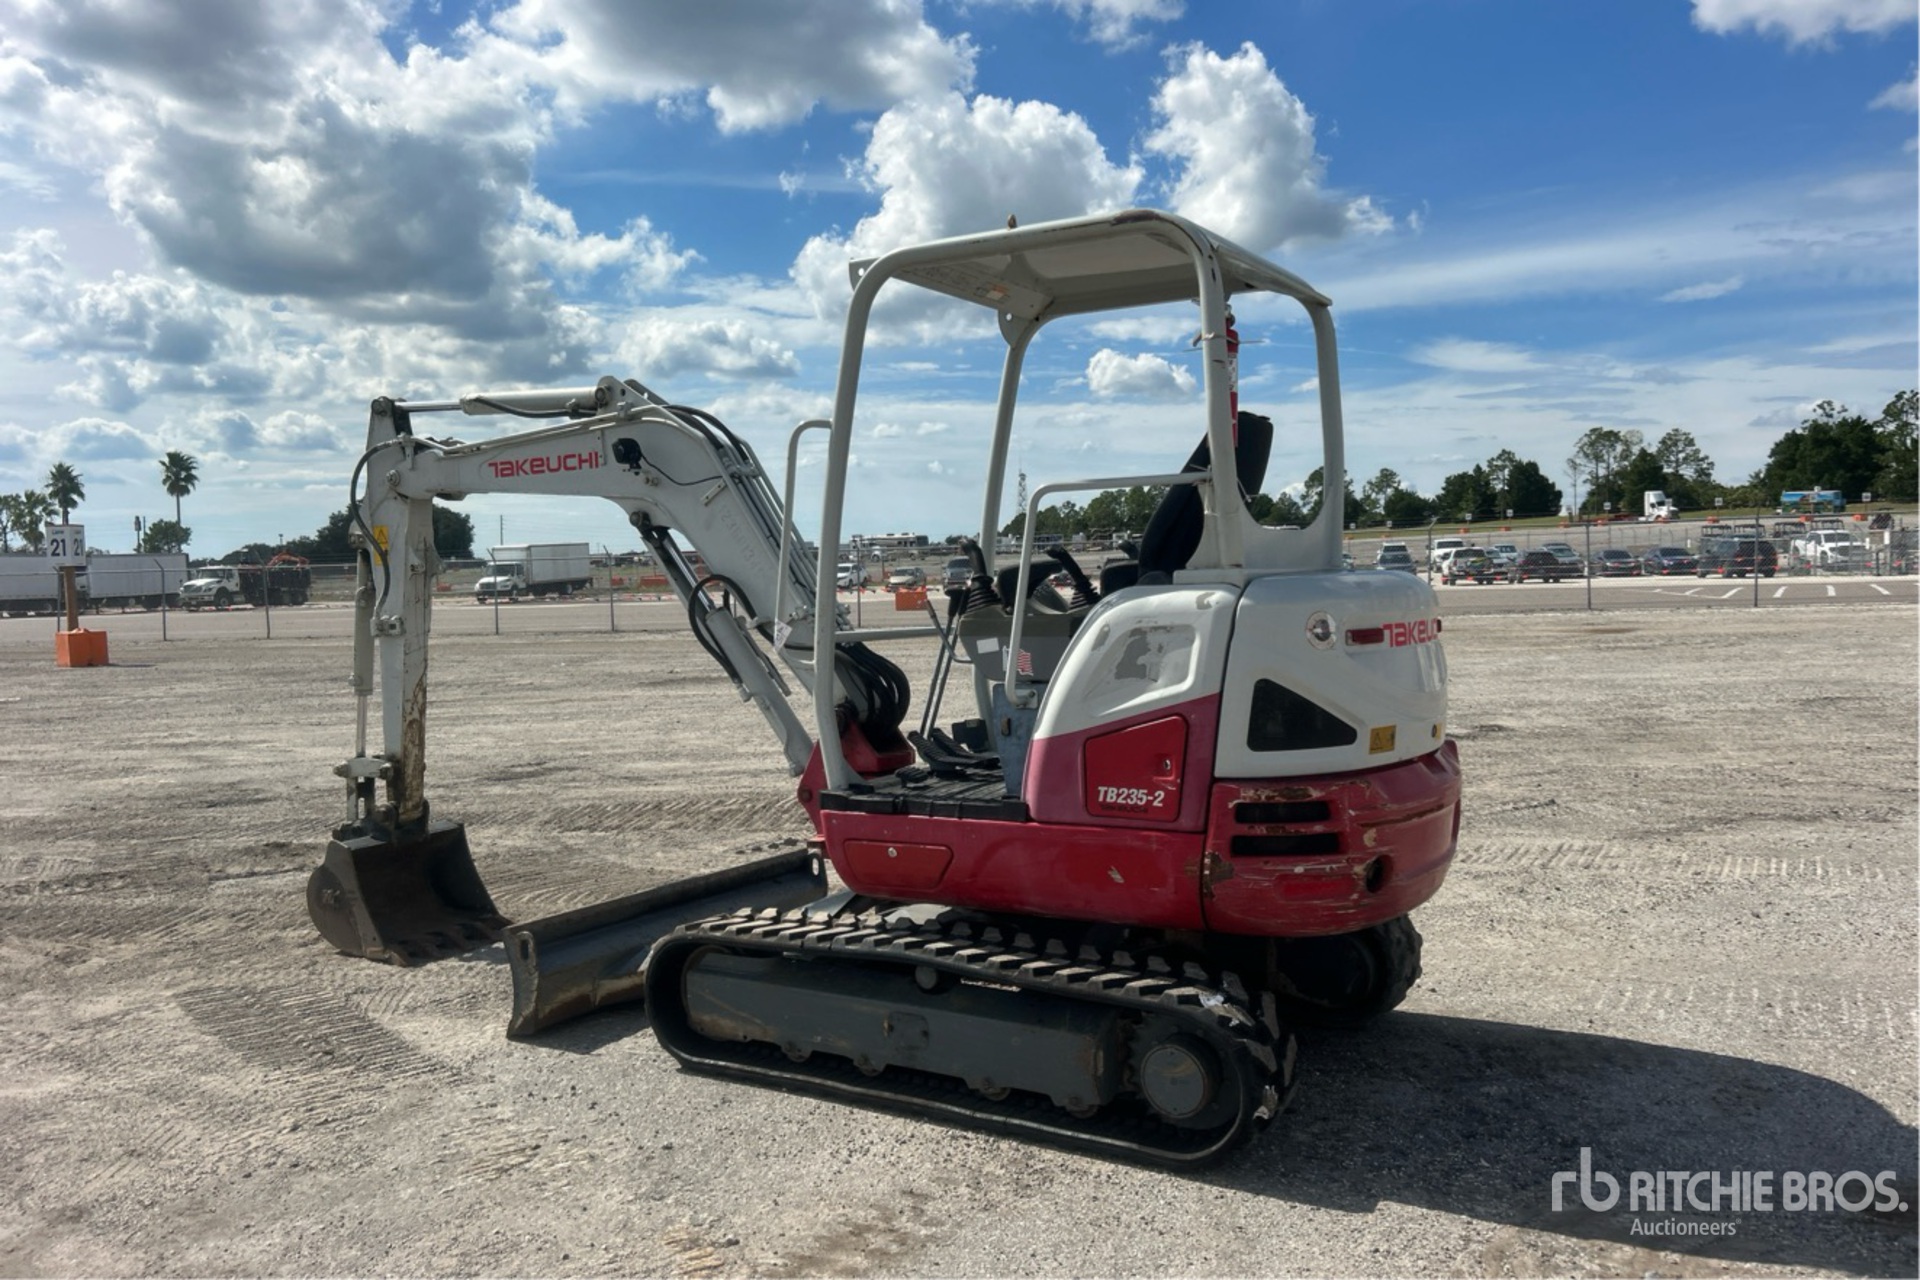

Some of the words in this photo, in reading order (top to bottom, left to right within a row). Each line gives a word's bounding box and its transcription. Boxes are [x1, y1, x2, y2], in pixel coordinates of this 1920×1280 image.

[50, 538, 66, 557] 21
[73, 538, 84, 557] 21
[1098, 786, 1165, 807] TB235-2
